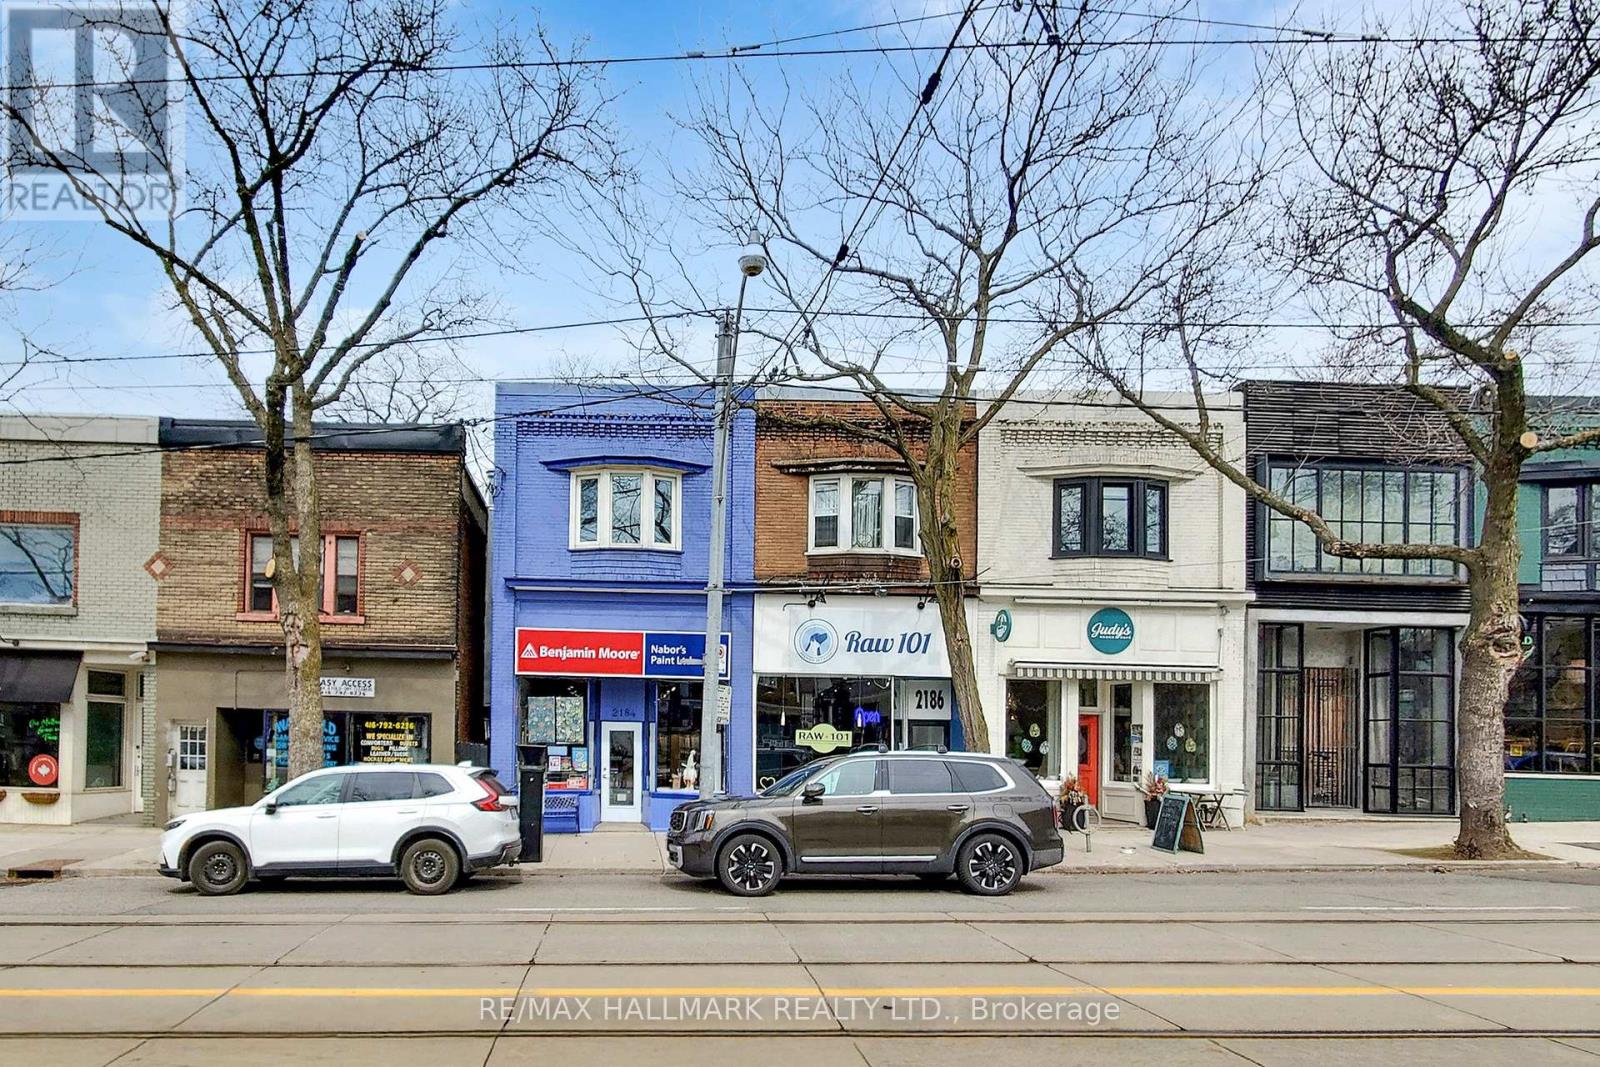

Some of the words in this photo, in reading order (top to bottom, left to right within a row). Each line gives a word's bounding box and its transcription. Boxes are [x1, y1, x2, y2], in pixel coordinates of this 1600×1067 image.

[1091, 622, 1132, 638] Judy's
[650, 644, 687, 655] Nabor's
[845, 630, 895, 654] Raw
[898, 632, 931, 654] 101
[539, 645, 596, 660] Benjamin
[599, 648, 637, 660] Moore
[650, 655, 675, 665] Paint
[320, 679, 337, 687] ASY
[341, 680, 372, 688] ACCESS
[915, 689, 945, 710] 2186
[854, 707, 880, 729] Open
[799, 732, 824, 741] RAW
[832, 733, 850, 741] 101
